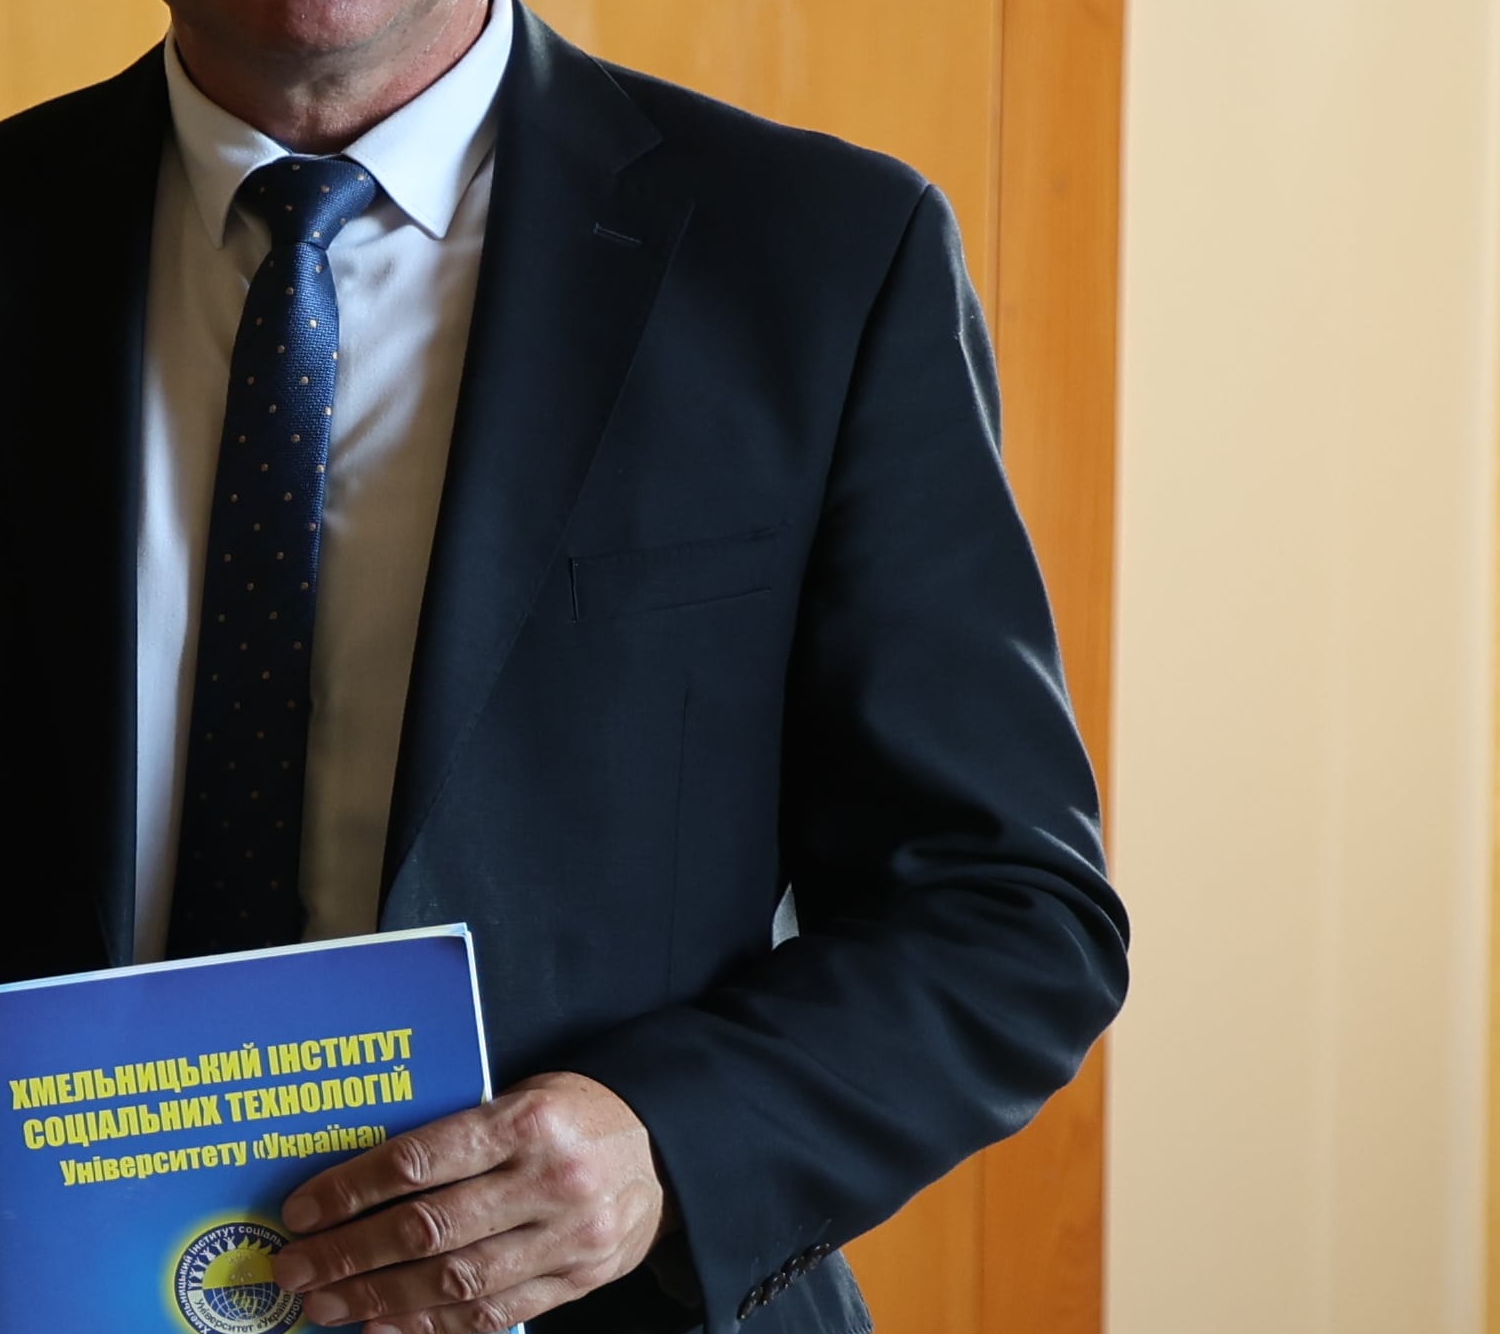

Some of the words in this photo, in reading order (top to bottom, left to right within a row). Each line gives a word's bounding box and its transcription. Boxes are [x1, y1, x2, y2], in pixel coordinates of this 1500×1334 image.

[9, 1042, 262, 1110] ХМЕЛЬНИЦЬКИЙ
[267, 1028, 412, 1075] ІНСТИТУТ
[22, 1095, 222, 1149] СОЦІАЛЬНИХ
[225, 1065, 413, 1123] ТЕХНОЛОГІЙ
[60, 1138, 247, 1186] Університету
[253, 1125, 386, 1161] «Україна»
[238, 1225, 282, 1247] соціаль
[195, 1298, 254, 1333] Університет
